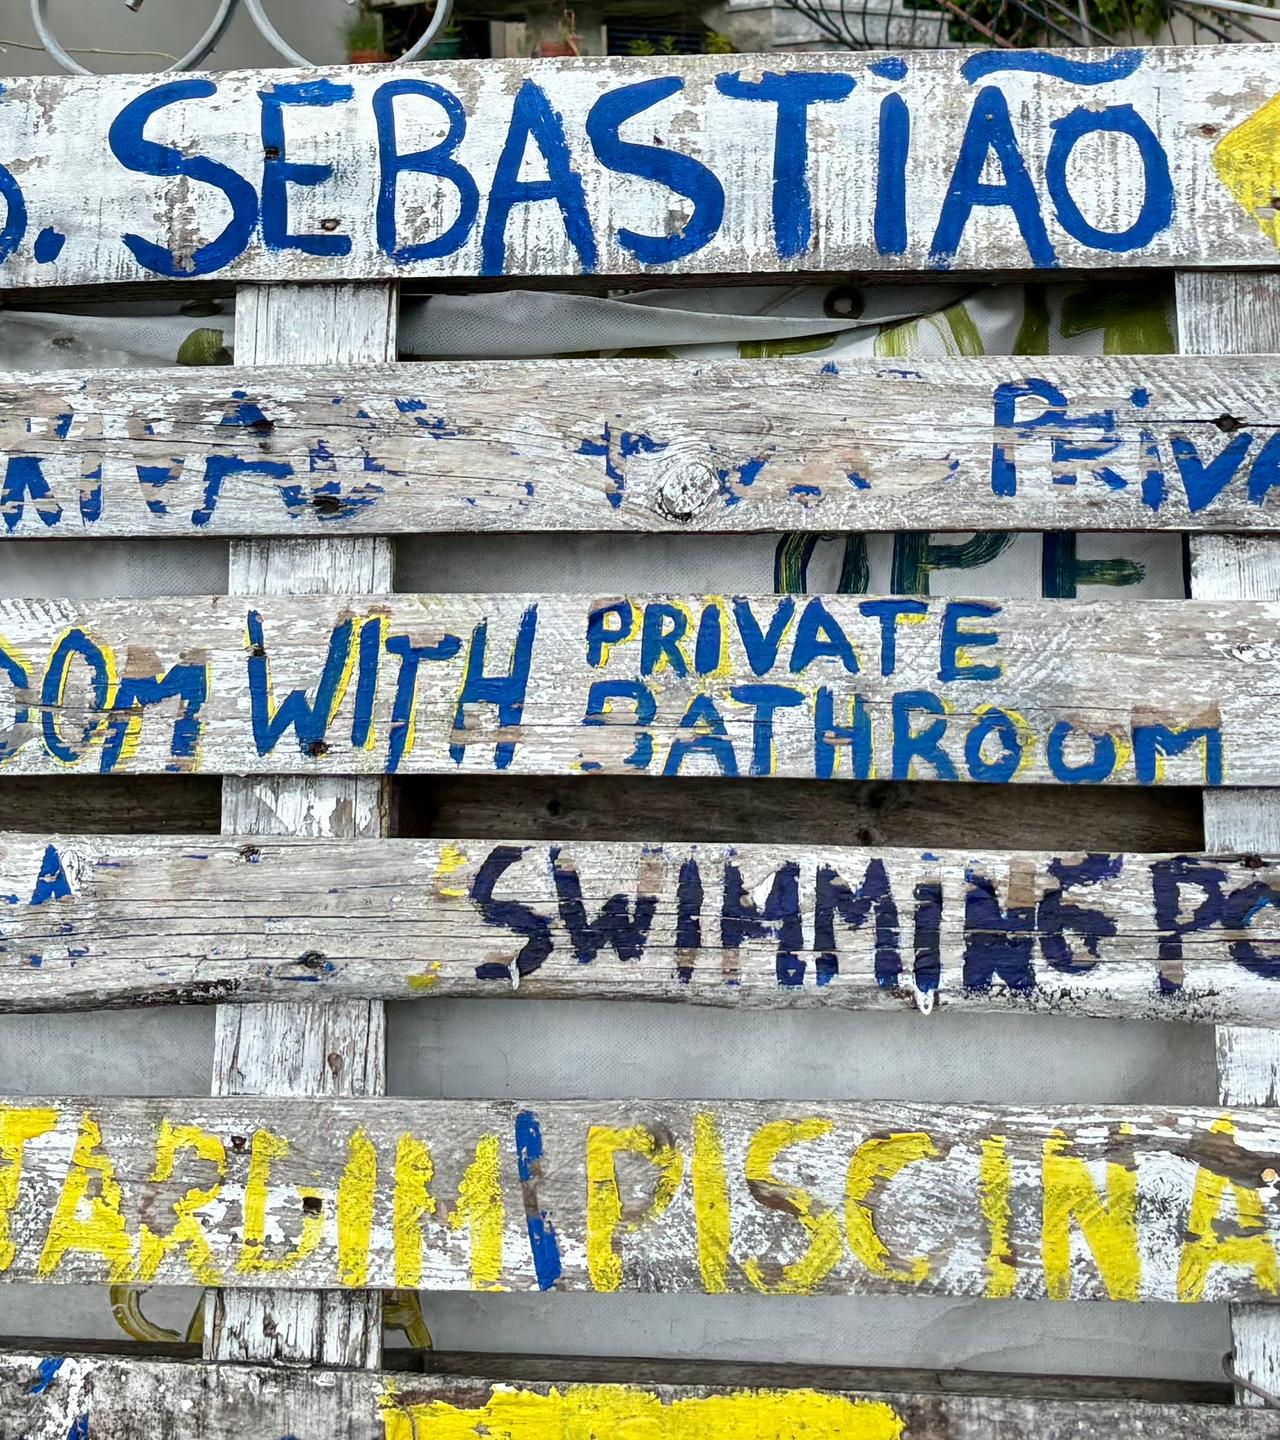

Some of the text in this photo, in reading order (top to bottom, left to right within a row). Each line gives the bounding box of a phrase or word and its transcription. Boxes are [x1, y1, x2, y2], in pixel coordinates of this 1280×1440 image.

[248, 606, 537, 775] WITH
[587, 597, 1001, 682] PRIVATE
[472, 846, 1122, 994] SWIMMING
[587, 1115, 1278, 1301] PISCINA
